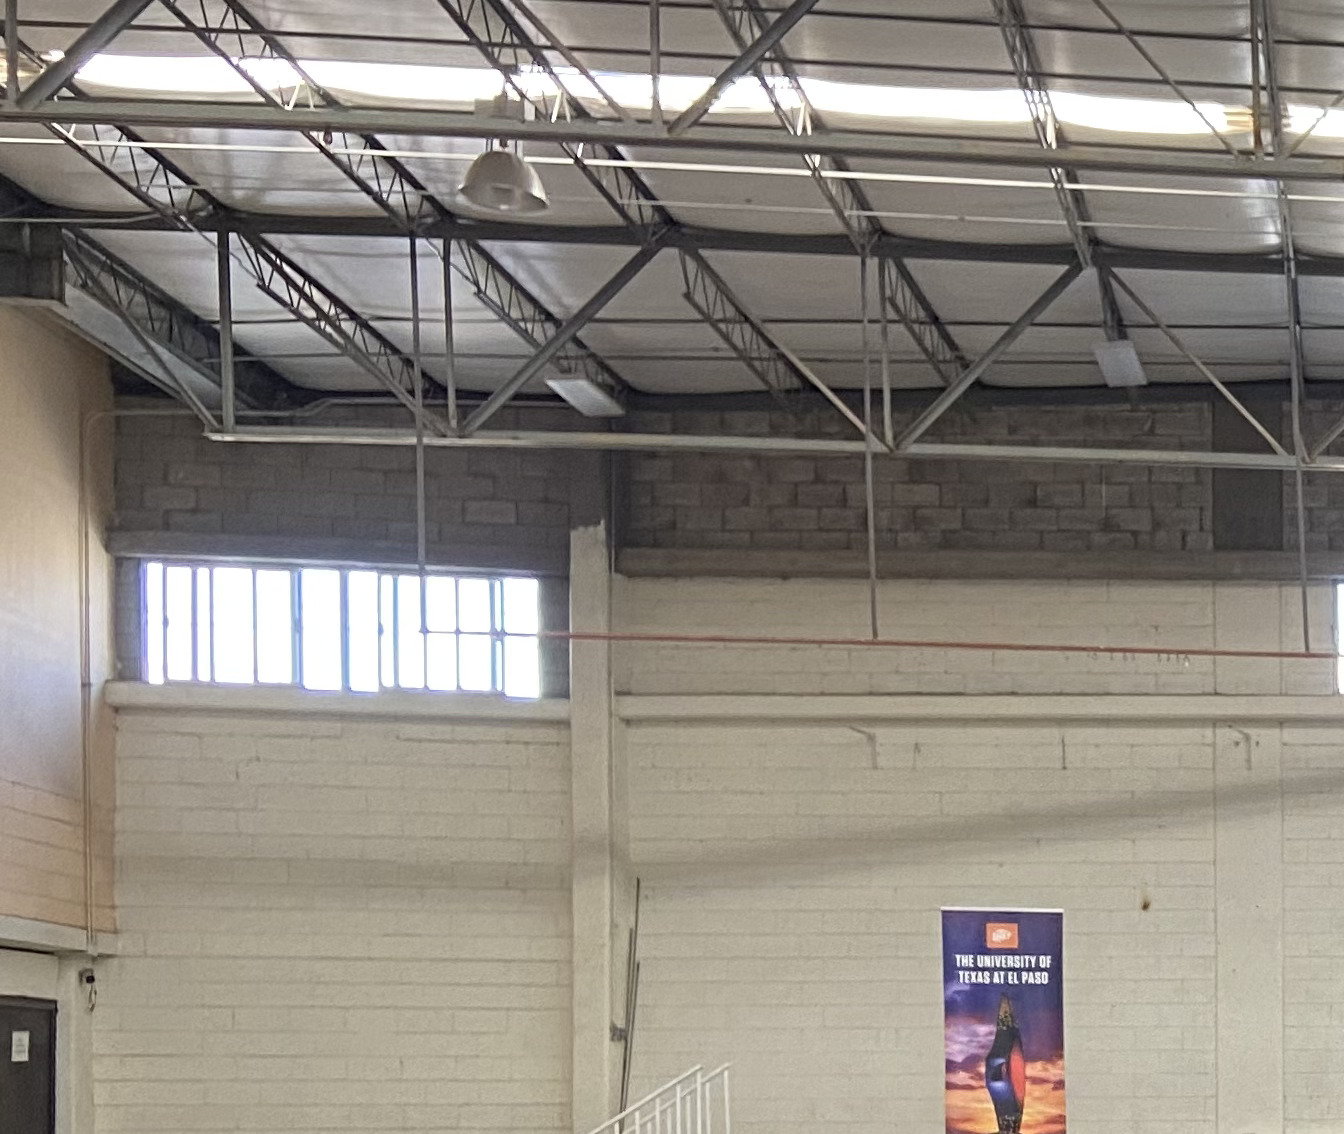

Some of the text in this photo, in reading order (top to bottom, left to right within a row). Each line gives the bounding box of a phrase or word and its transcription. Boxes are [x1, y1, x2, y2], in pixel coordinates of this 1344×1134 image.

[955, 954, 1052, 969] THE UNIVERSITY OF
[958, 971, 1049, 985] TEXAS AT EL PASO
